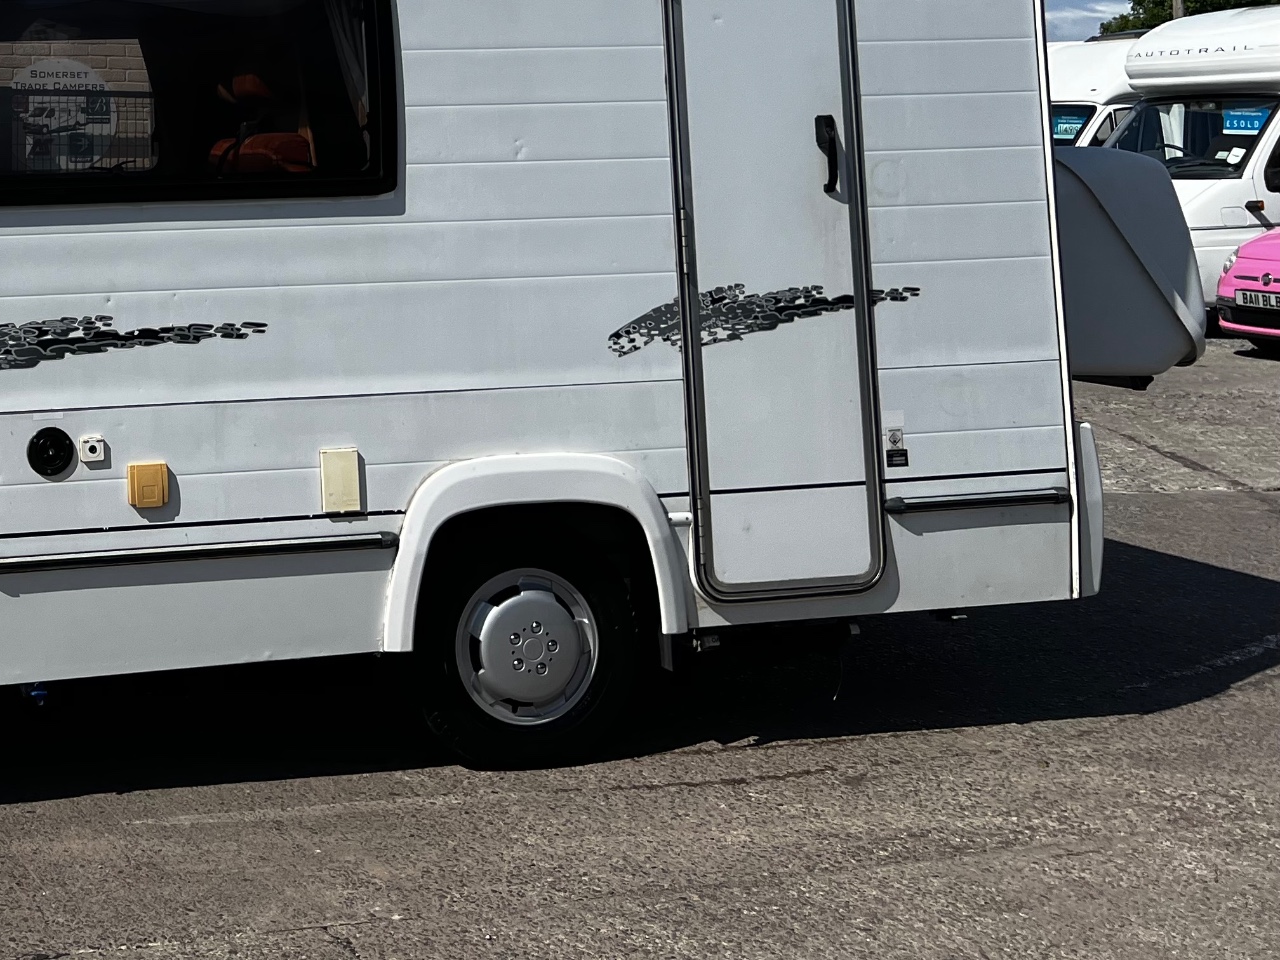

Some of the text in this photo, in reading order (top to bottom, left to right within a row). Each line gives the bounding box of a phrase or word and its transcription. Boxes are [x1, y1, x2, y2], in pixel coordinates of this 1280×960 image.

[1134, 45, 1254, 58] AUTOTRAIL
[30, 70, 90, 79] SOMERSET
[13, 82, 105, 91] TRADE CAMPERS
[1233, 120, 1259, 128] SOLD
